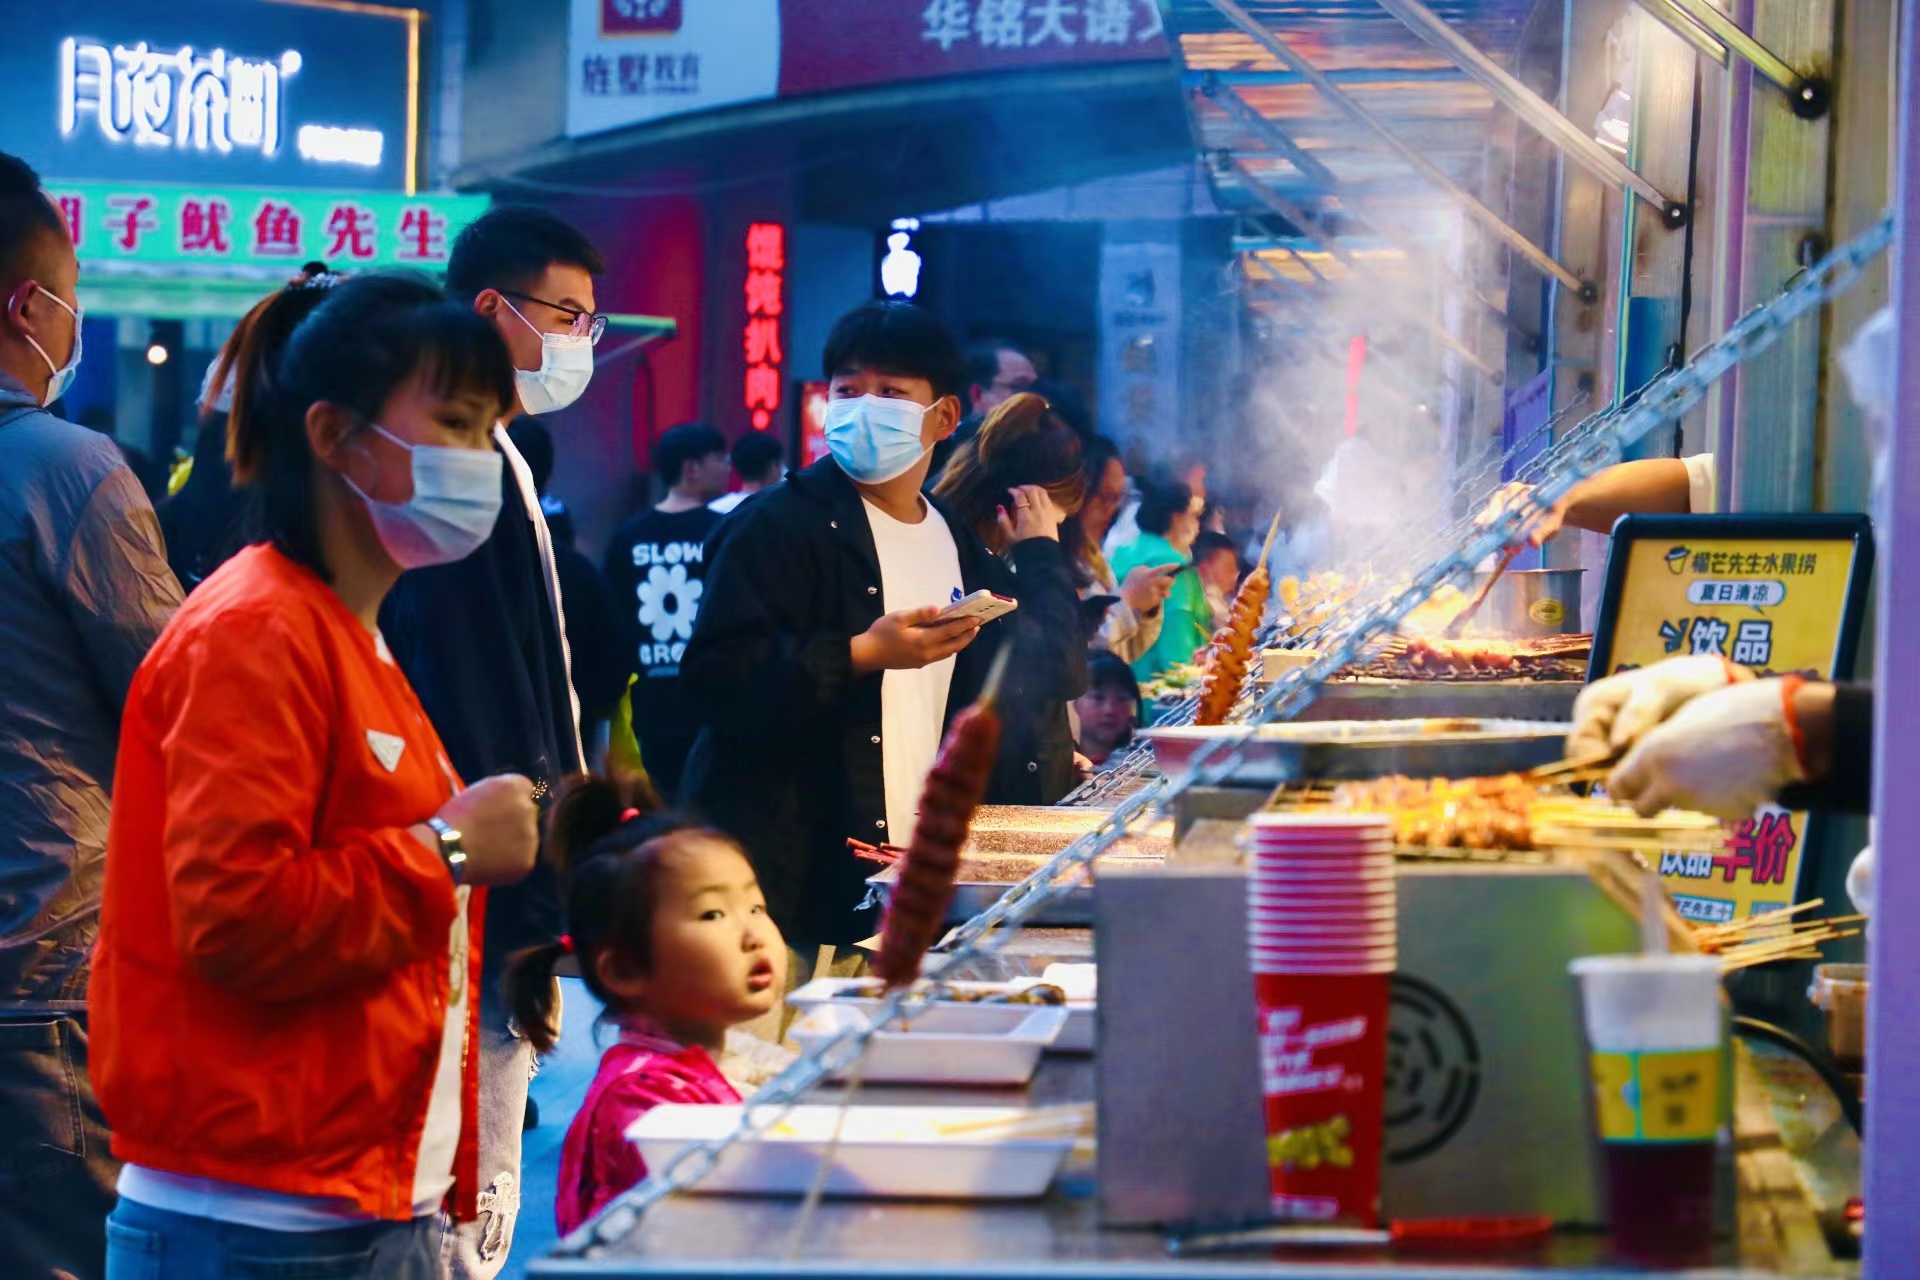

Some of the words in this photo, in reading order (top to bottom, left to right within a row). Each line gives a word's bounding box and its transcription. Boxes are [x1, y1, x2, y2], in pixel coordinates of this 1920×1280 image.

[632, 541, 704, 566] SLOW
[1700, 583, 1769, 602] 夏日清凉
[1690, 617, 1773, 665] 饮品
